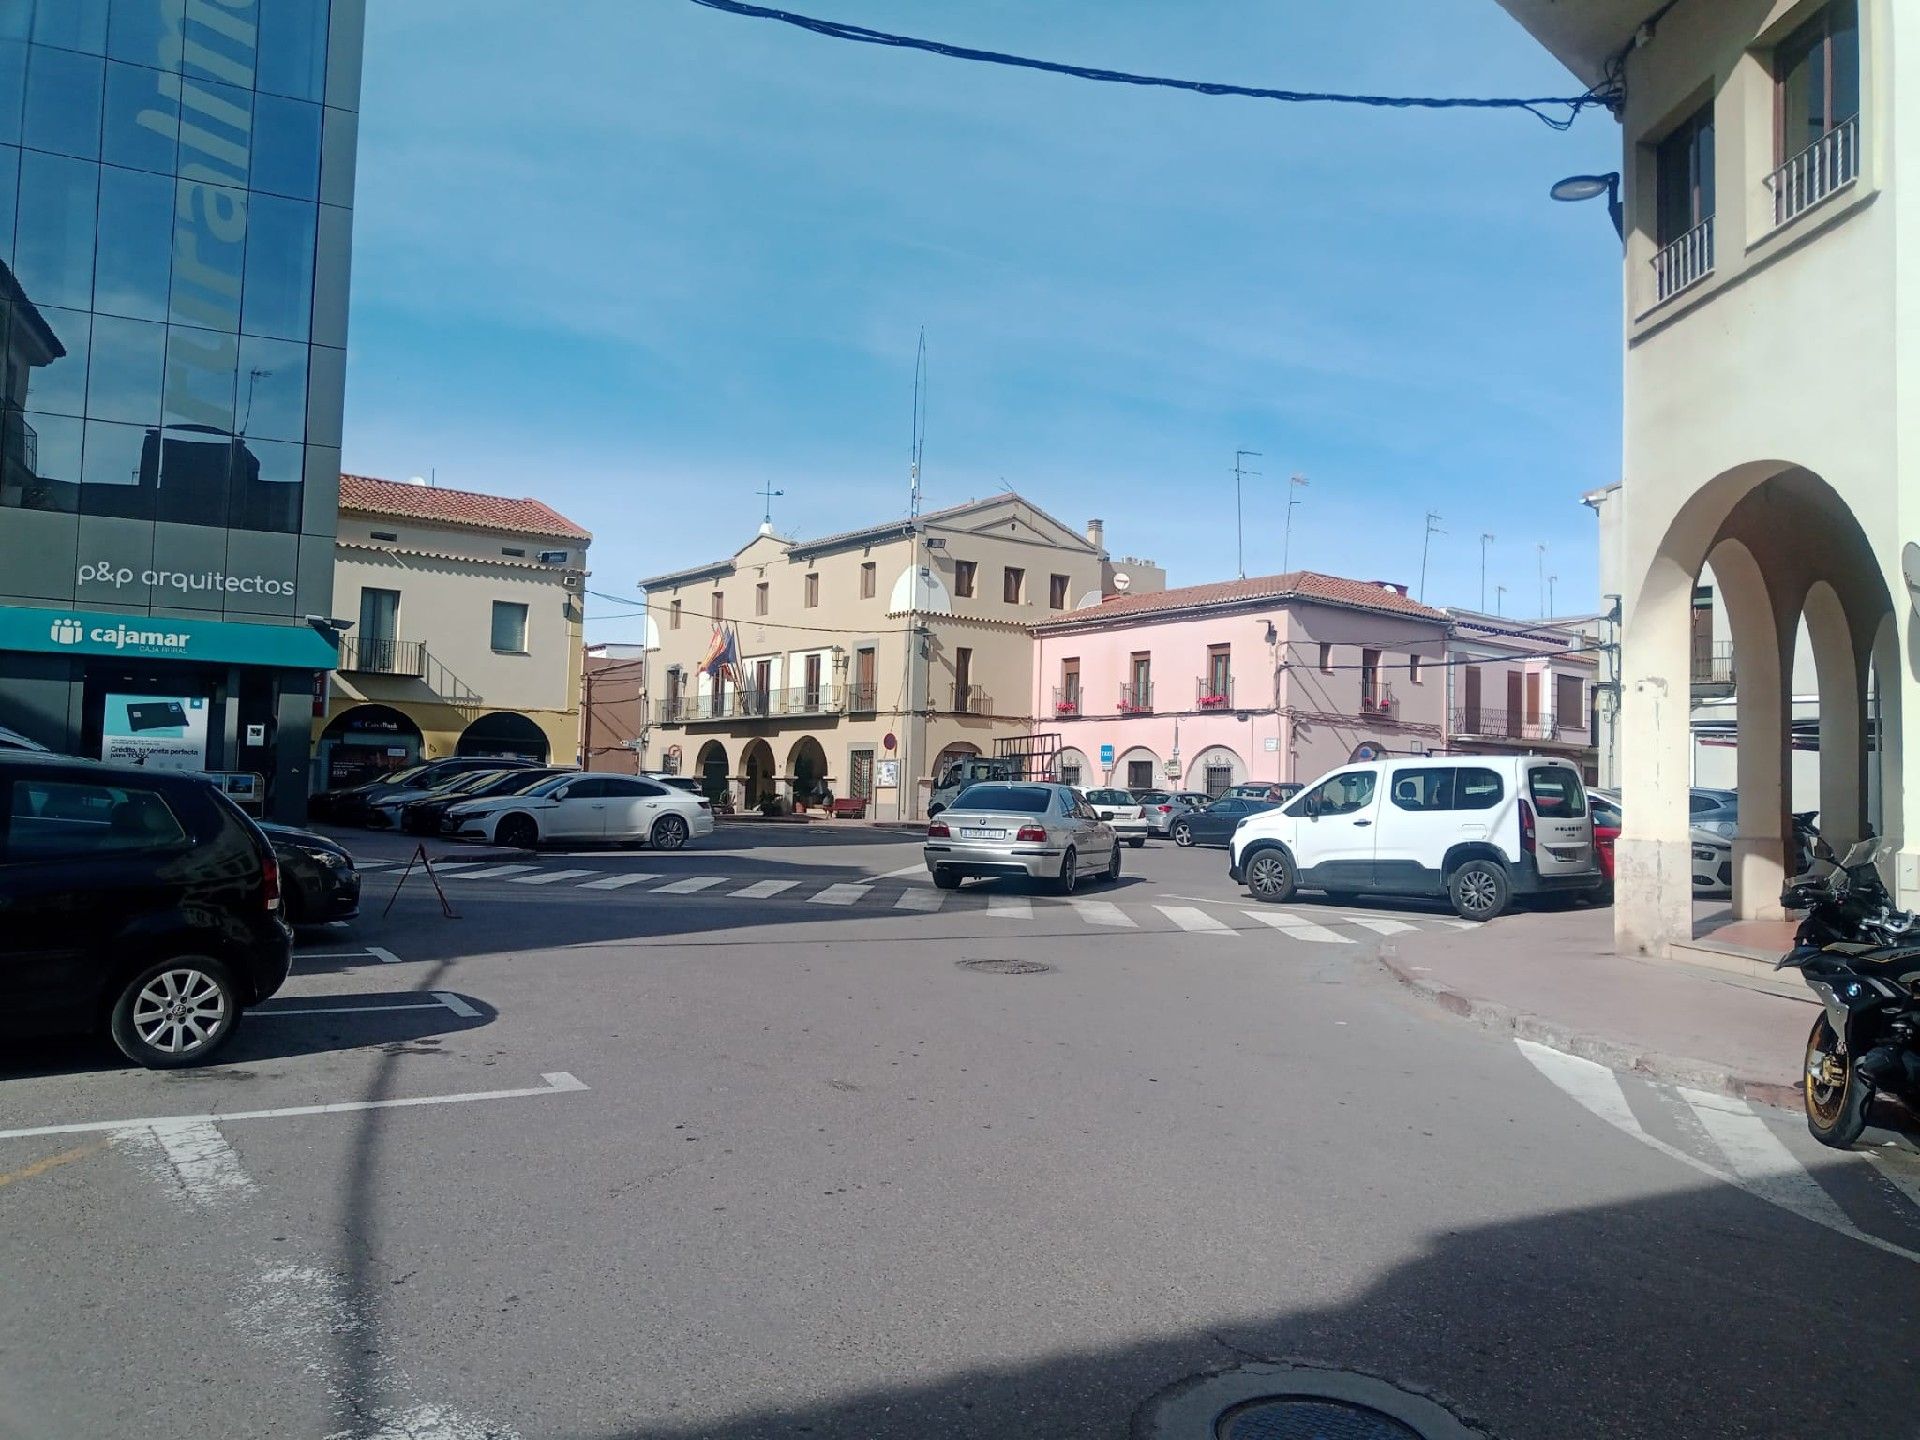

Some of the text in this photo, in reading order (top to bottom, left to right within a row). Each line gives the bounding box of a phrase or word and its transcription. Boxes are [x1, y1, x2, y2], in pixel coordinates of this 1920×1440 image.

[77, 561, 295, 596] p&p arquitectos
[90, 624, 191, 649] cajamar
